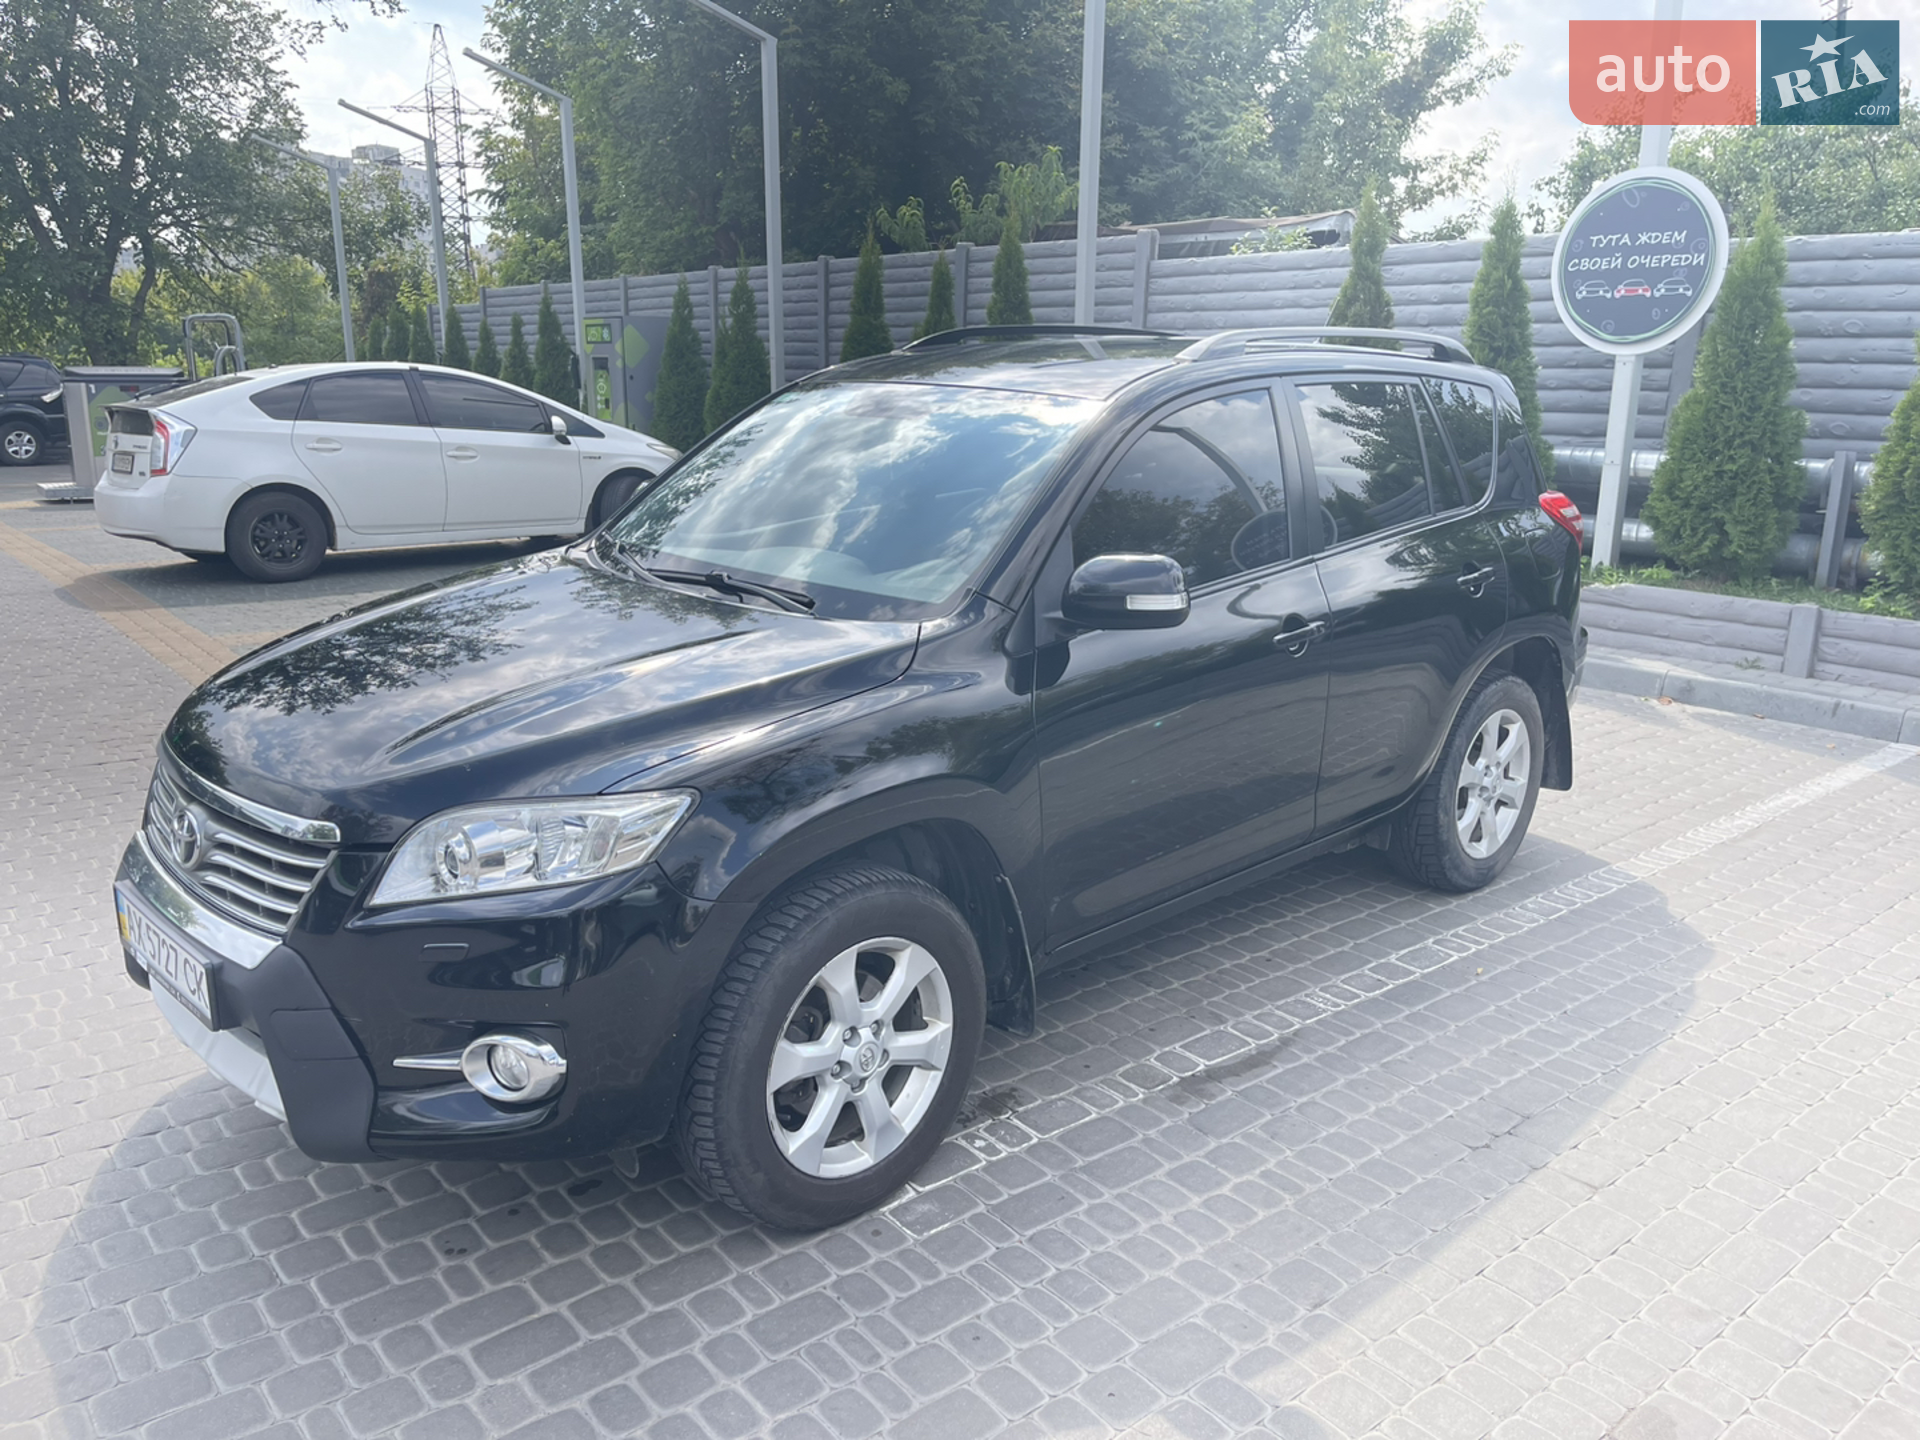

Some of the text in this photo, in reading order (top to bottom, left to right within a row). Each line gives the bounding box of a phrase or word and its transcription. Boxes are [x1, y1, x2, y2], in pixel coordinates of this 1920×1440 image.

[1590, 230, 1687, 248] ТУТА ЖДЕМ
[1568, 252, 1705, 271] СВОЕЙ ОЧЕРЕДИ
[127, 904, 146, 952] AX
[146, 926, 178, 981] 5727
[184, 957, 209, 1009] CK
